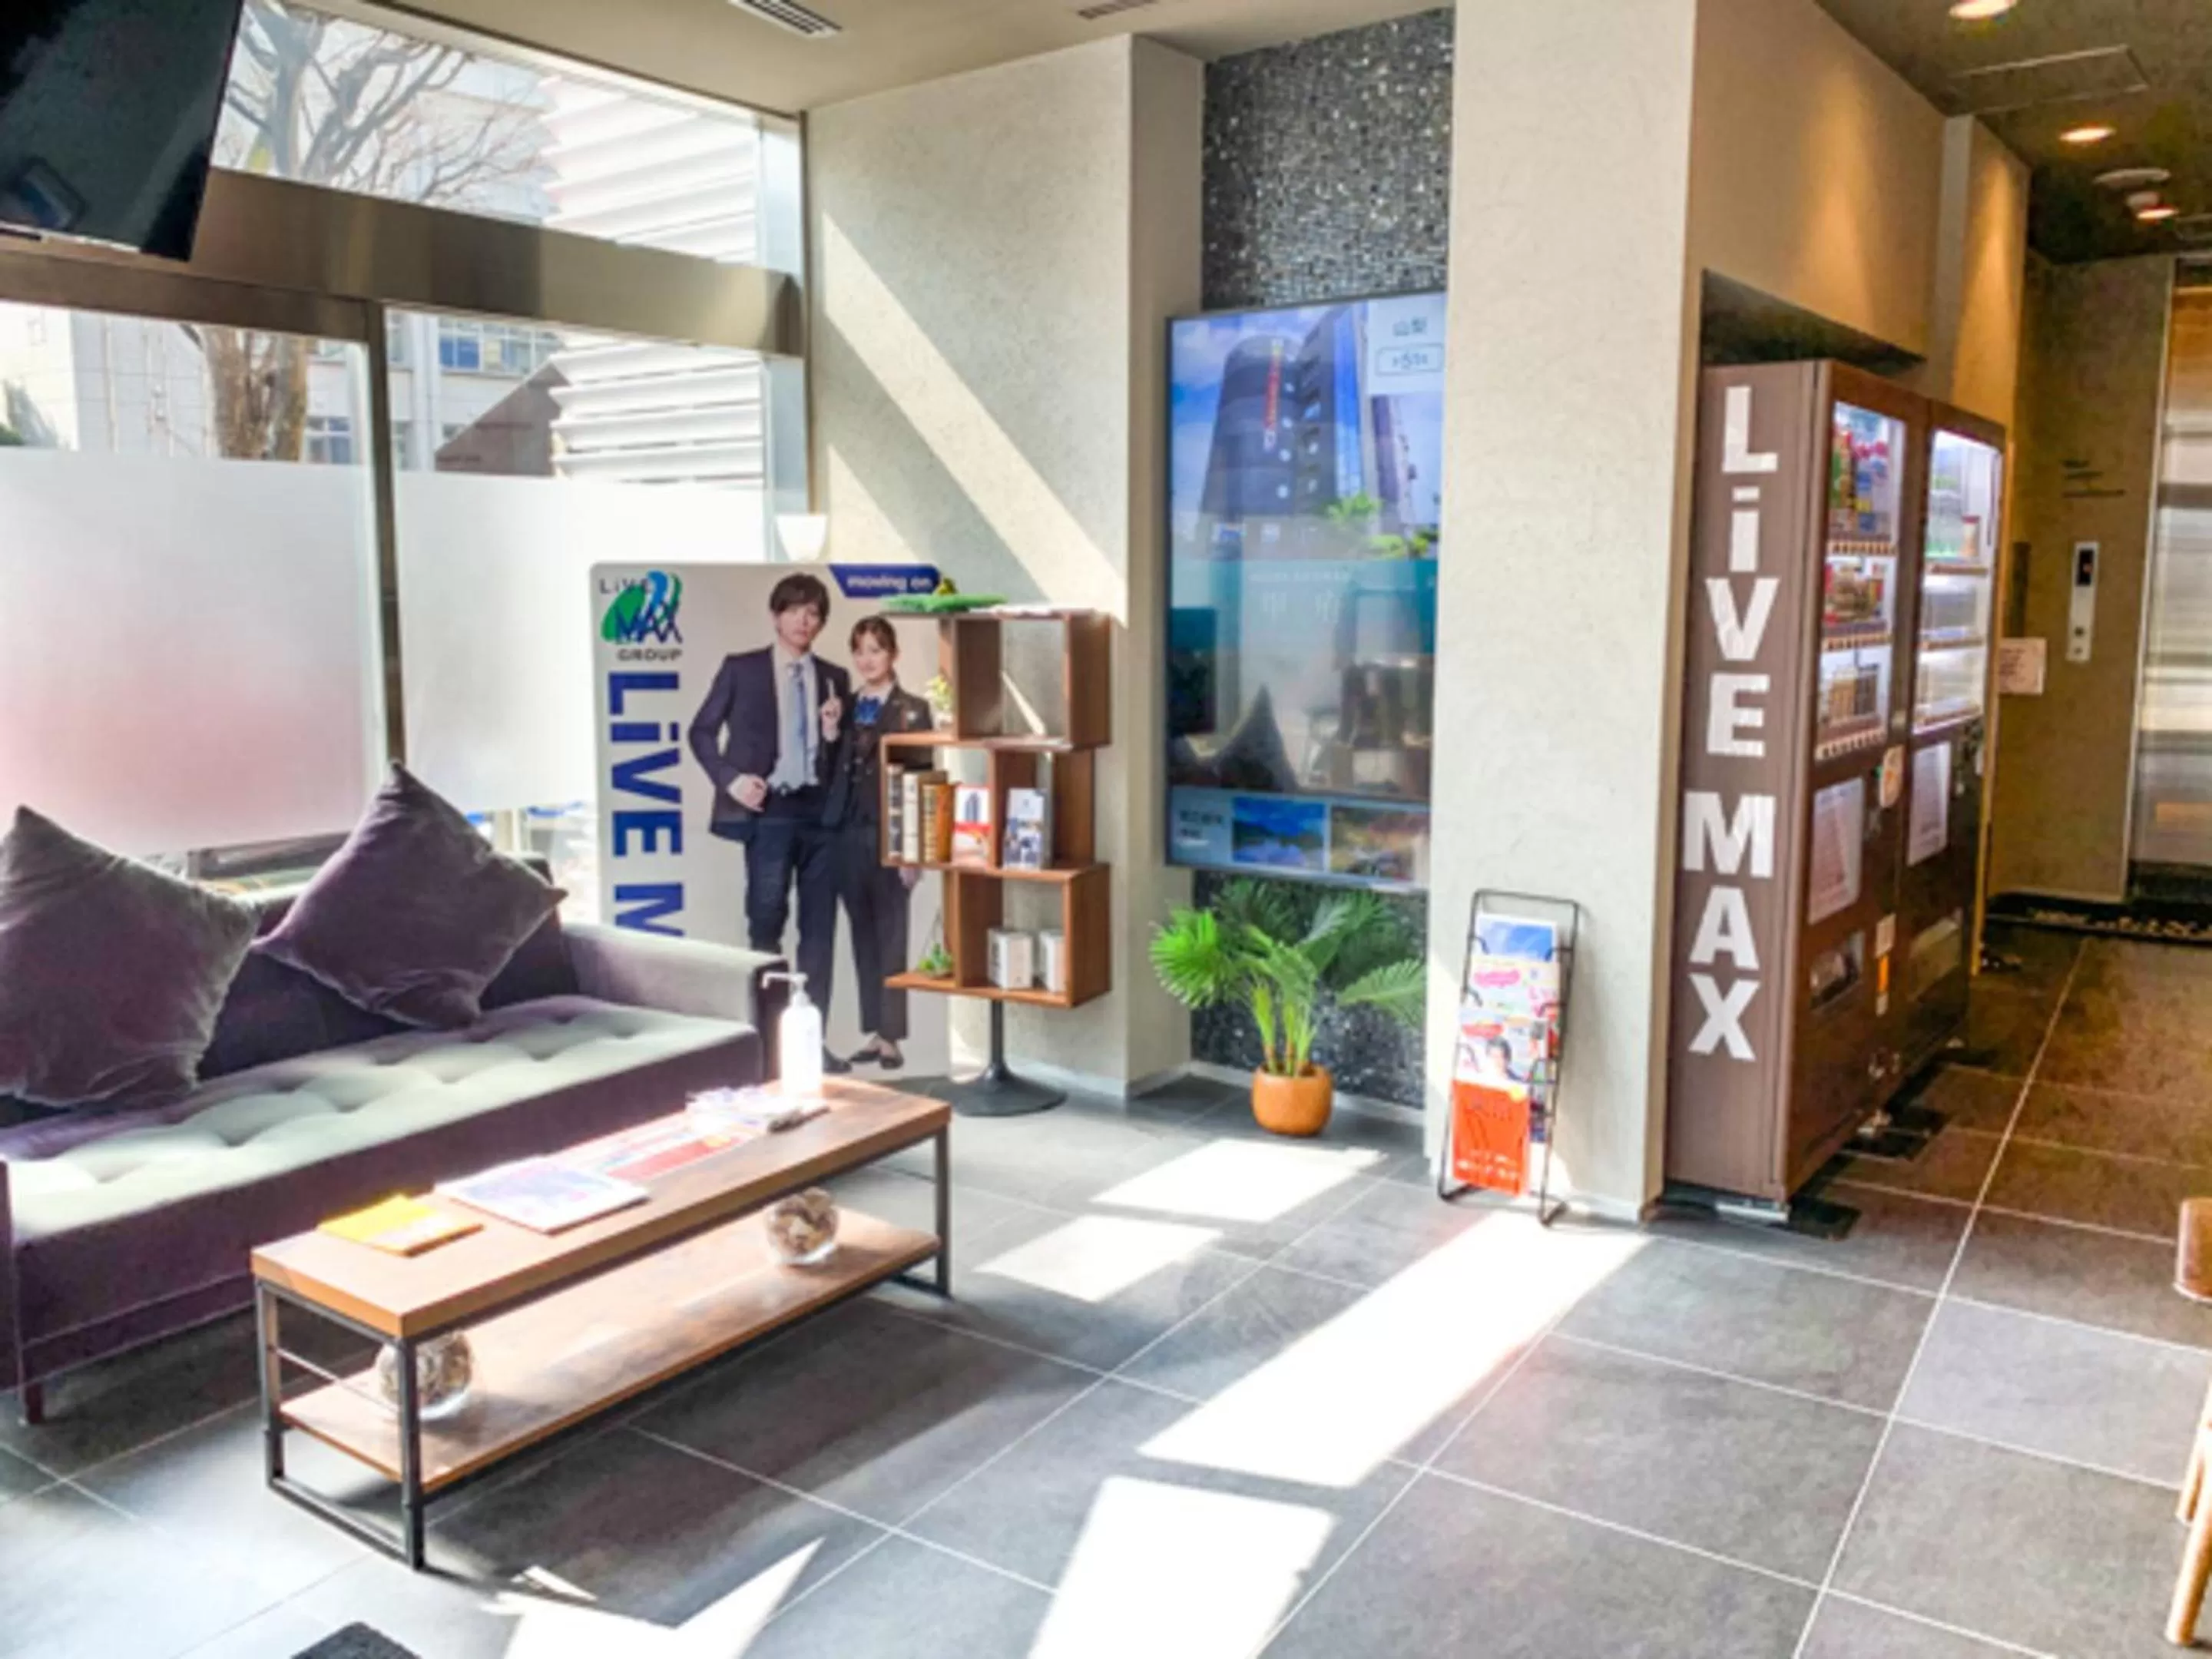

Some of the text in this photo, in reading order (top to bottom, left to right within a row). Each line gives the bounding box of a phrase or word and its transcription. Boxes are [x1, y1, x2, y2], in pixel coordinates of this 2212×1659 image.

[617, 648, 683, 661] GROUP
[1684, 386, 1780, 1062] LiVE MAX
[608, 671, 683, 858] LiVE
